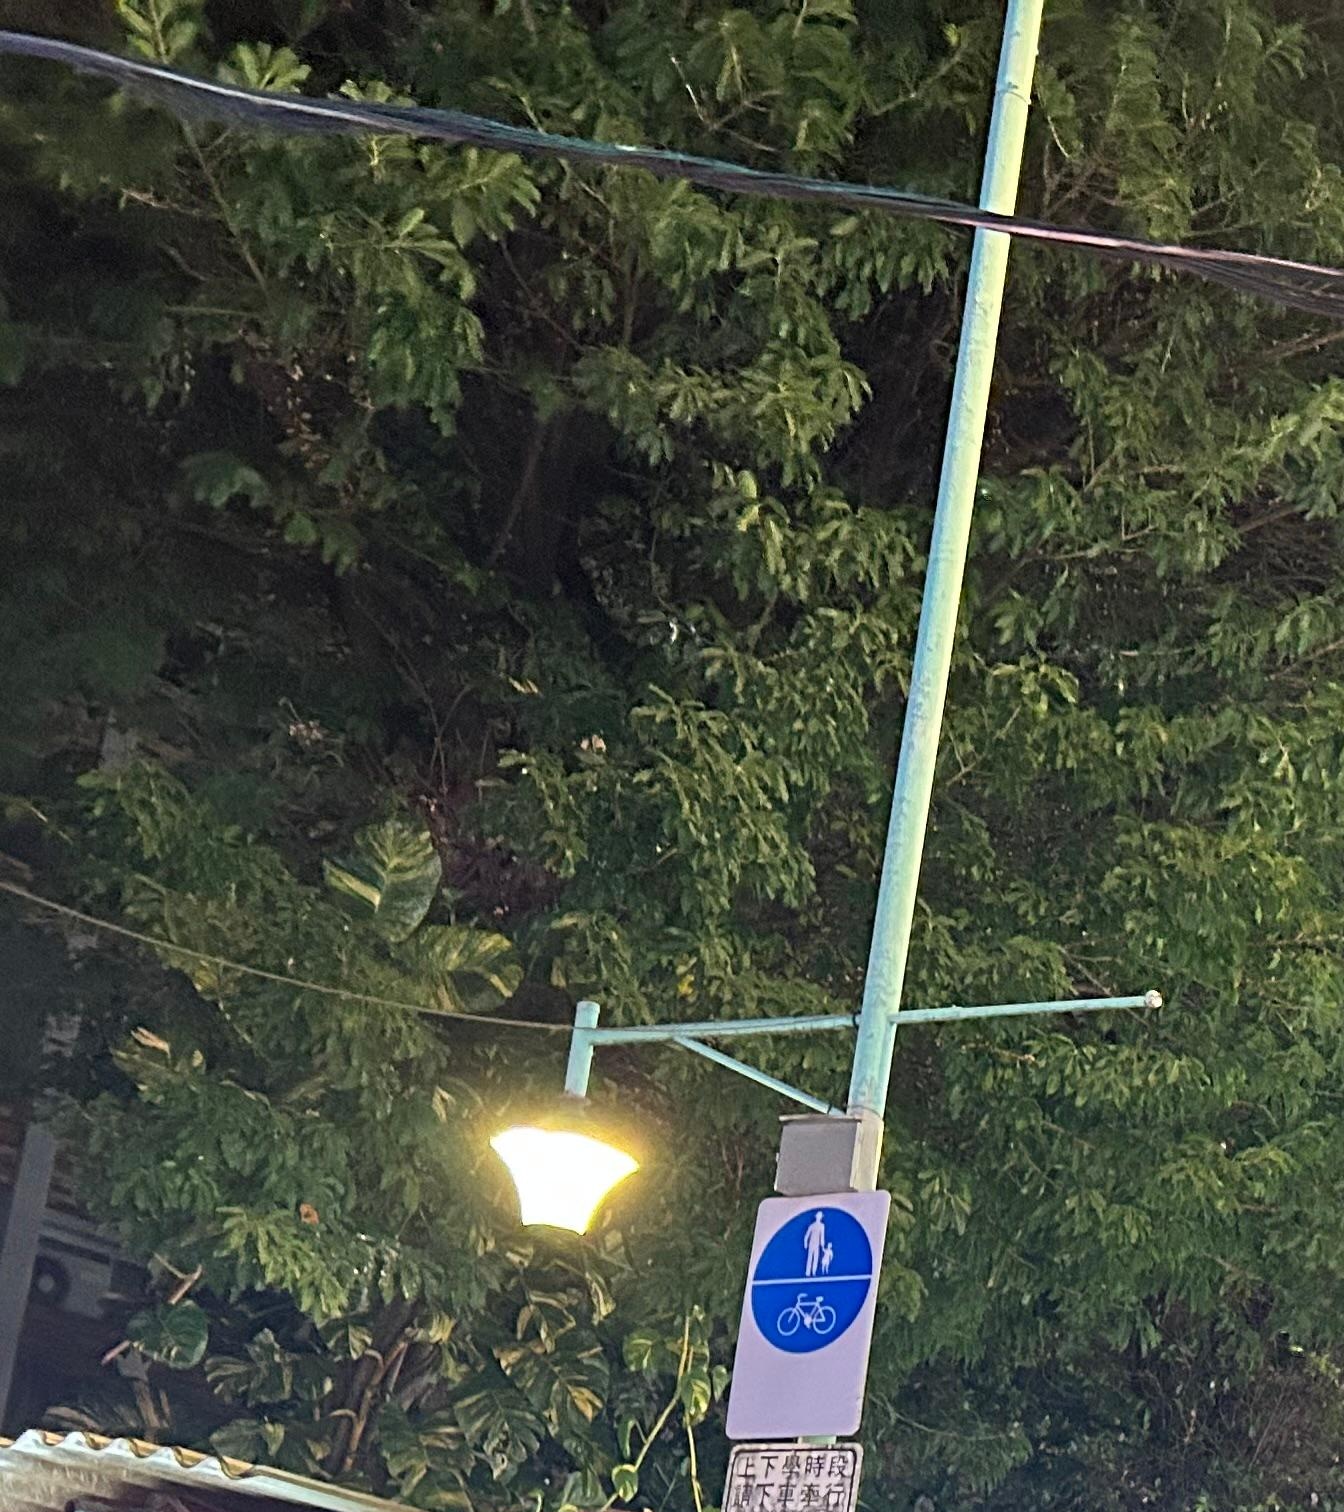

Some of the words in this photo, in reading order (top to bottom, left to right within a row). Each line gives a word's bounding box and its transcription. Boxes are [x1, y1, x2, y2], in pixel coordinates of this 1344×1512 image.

[737, 1451, 850, 1479] 上下學時段
